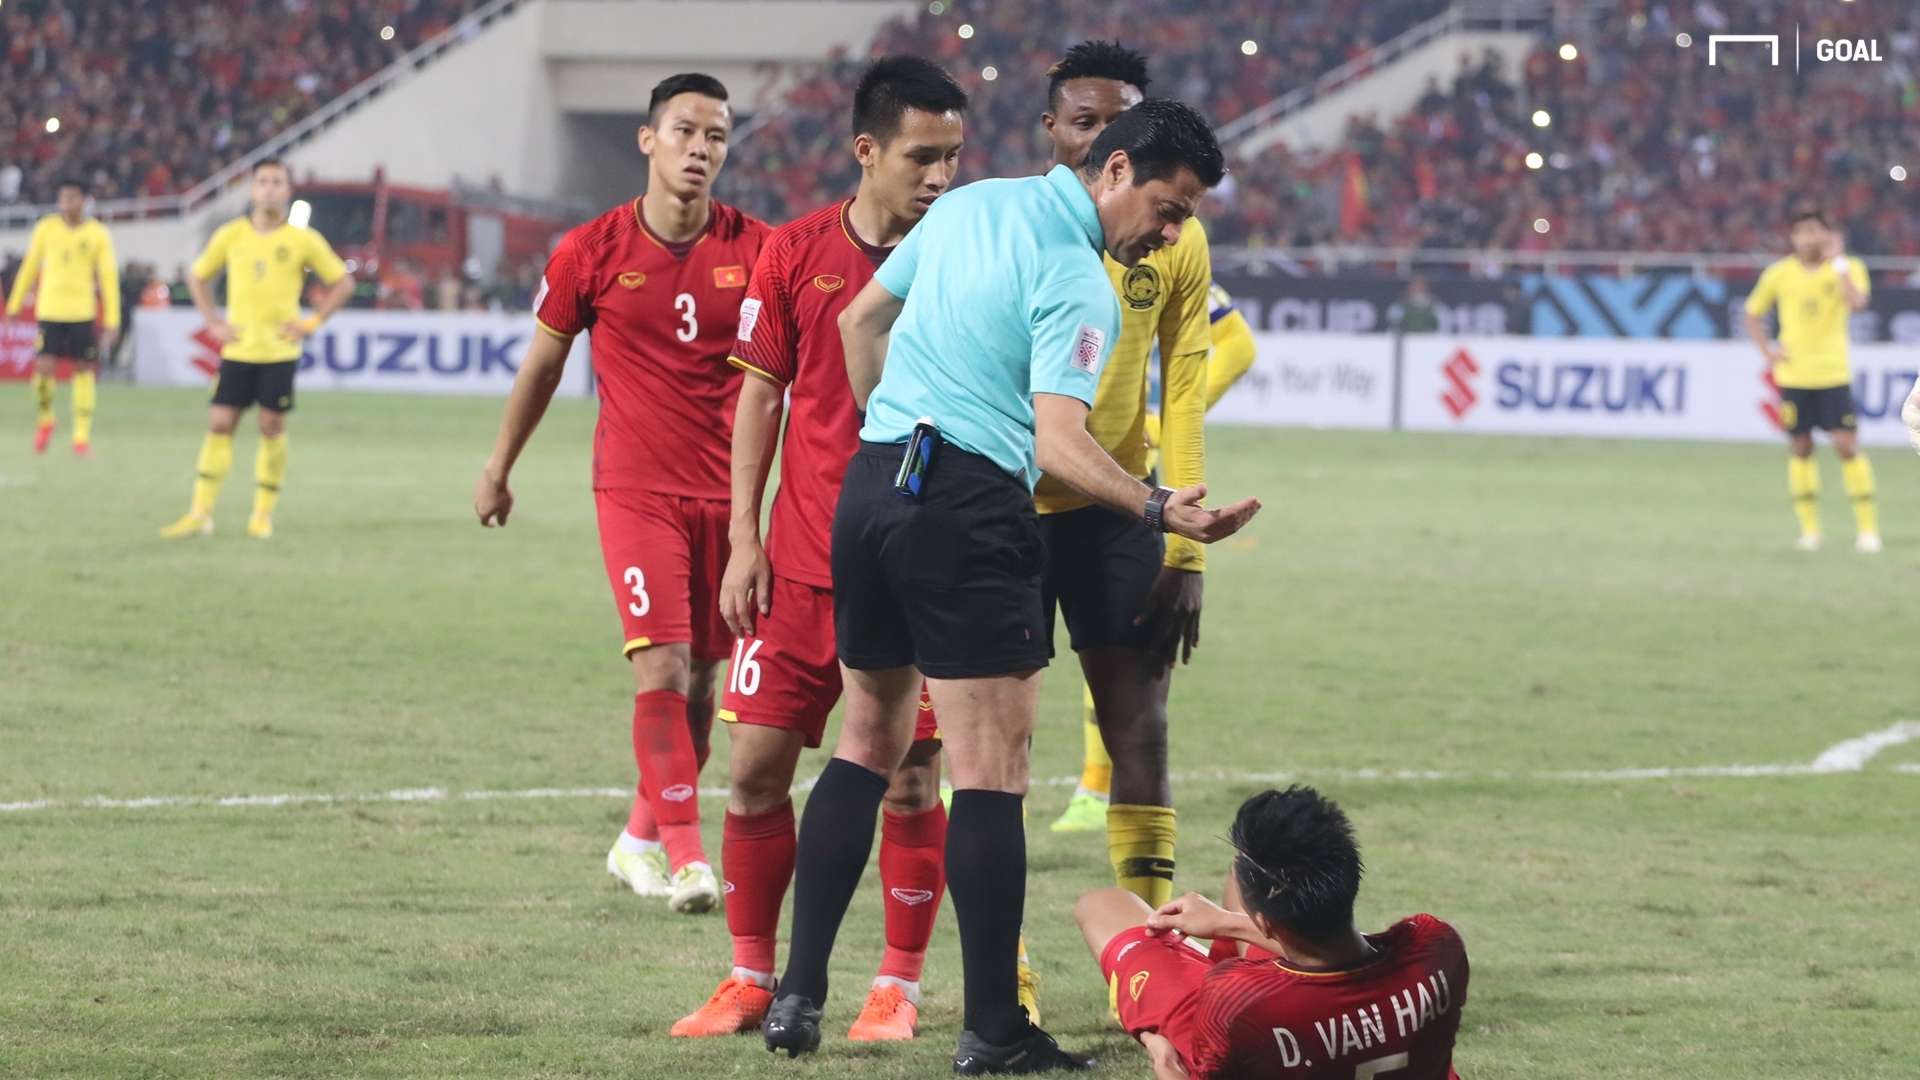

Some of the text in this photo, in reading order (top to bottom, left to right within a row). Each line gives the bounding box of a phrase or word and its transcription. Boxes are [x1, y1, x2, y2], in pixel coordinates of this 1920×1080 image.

[674, 293, 698, 342] 3
[299, 332, 526, 375] UZUK
[1496, 363, 1686, 414] SUZUKI
[623, 566, 650, 617] 3
[729, 638, 763, 696] 16
[1272, 1027, 1312, 1068] D.
[1314, 1003, 1387, 1060] VAN
[1390, 969, 1450, 1037] HAU
